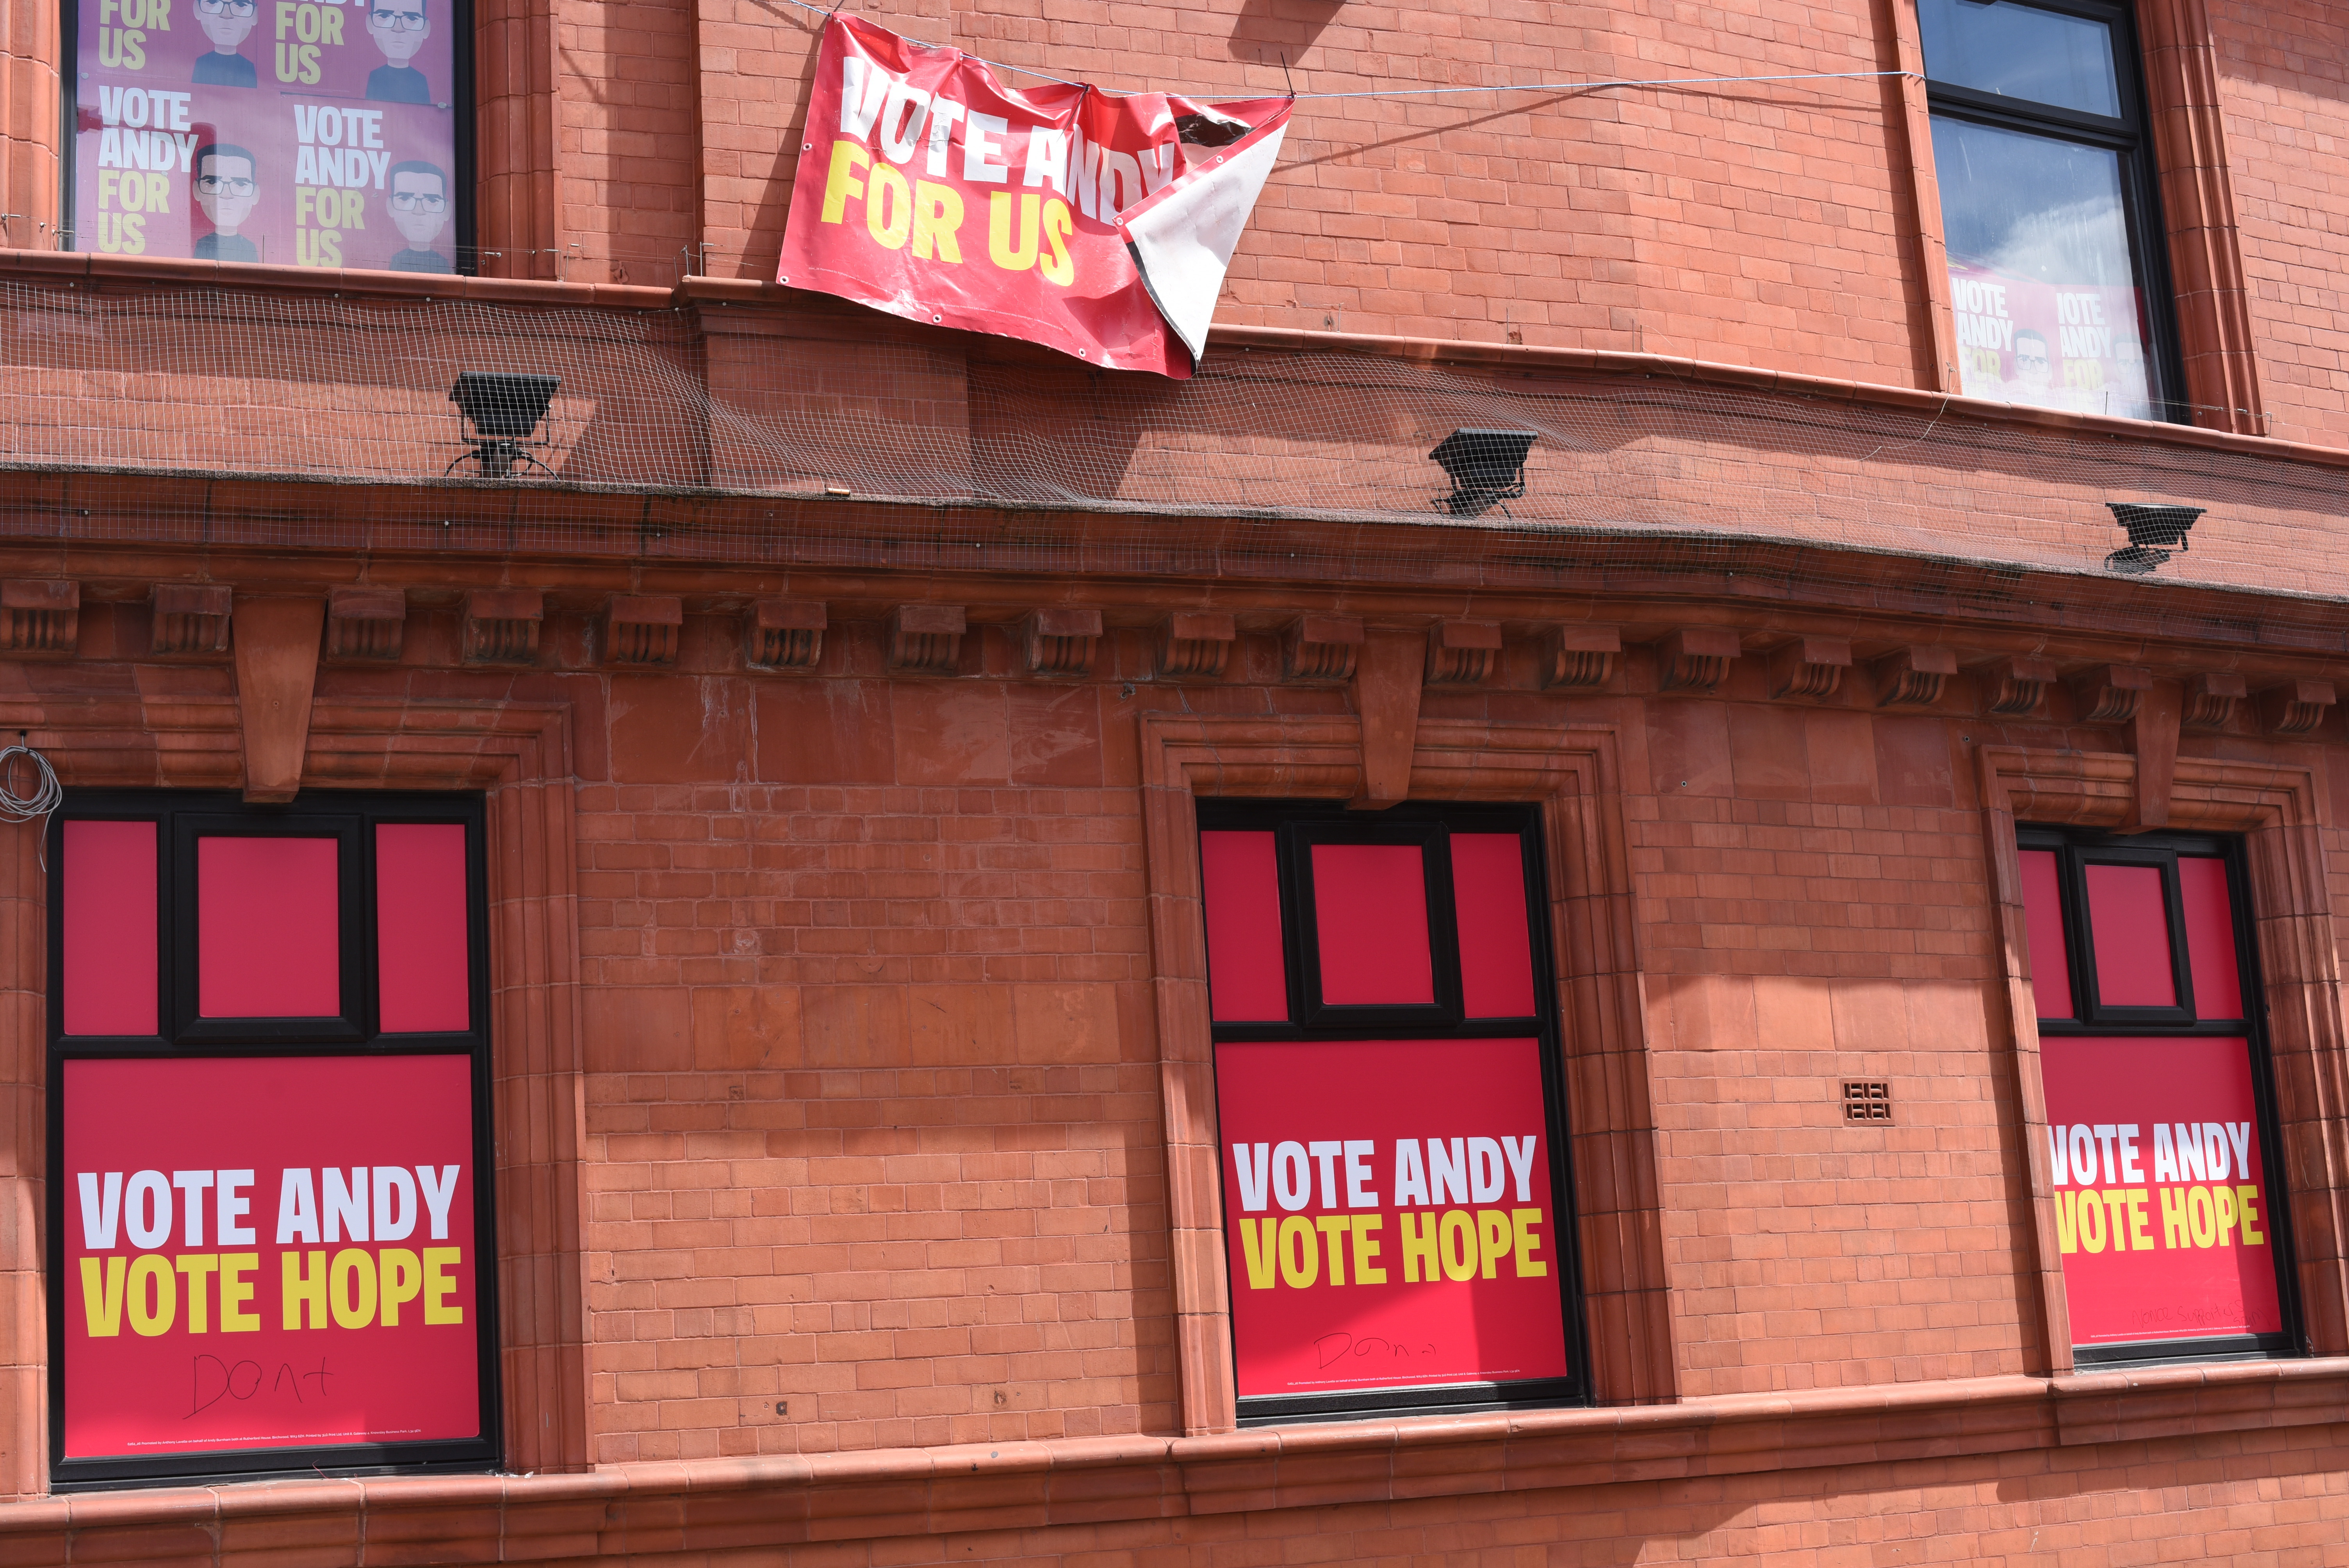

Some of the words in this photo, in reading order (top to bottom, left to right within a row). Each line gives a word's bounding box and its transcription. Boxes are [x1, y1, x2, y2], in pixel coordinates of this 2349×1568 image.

[100, 0, 171, 31] FOR
[276, 2, 344, 45] FOR
[99, 27, 146, 70] US
[276, 42, 321, 84] US
[99, 86, 191, 131] VOTE
[294, 104, 383, 148] VOTE
[98, 128, 199, 173] ANDY
[840, 56, 1008, 183] VOTE
[1023, 123, 1174, 226] ANDY
[295, 145, 391, 189] ANDY
[98, 169, 170, 213] FOR
[296, 186, 365, 230] FOR
[98, 212, 146, 254] US
[820, 140, 965, 265] FOR
[989, 191, 1074, 287] US
[296, 228, 342, 268] US
[1952, 277, 2008, 317] VOTE
[1958, 312, 2013, 351] ANDY
[2059, 326, 2111, 358] ANDY
[1959, 346, 2002, 383] FOR
[2063, 359, 2104, 390] FOR
[1232, 1140, 1379, 1211] VOTE
[1394, 1135, 1537, 1206] ANDY
[2047, 1124, 2145, 1186] VOTE
[2153, 1122, 2250, 1182] ANDY
[77, 1169, 256, 1249] VOTE
[276, 1164, 460, 1244] ANDY
[2054, 1188, 2155, 1254] VOTE
[2160, 1185, 2264, 1249] HOPE
[1239, 1213, 1387, 1290] VOTE
[1400, 1208, 1547, 1283] HOPE
[79, 1252, 260, 1337] VOTE
[282, 1246, 463, 1330] HOPE
